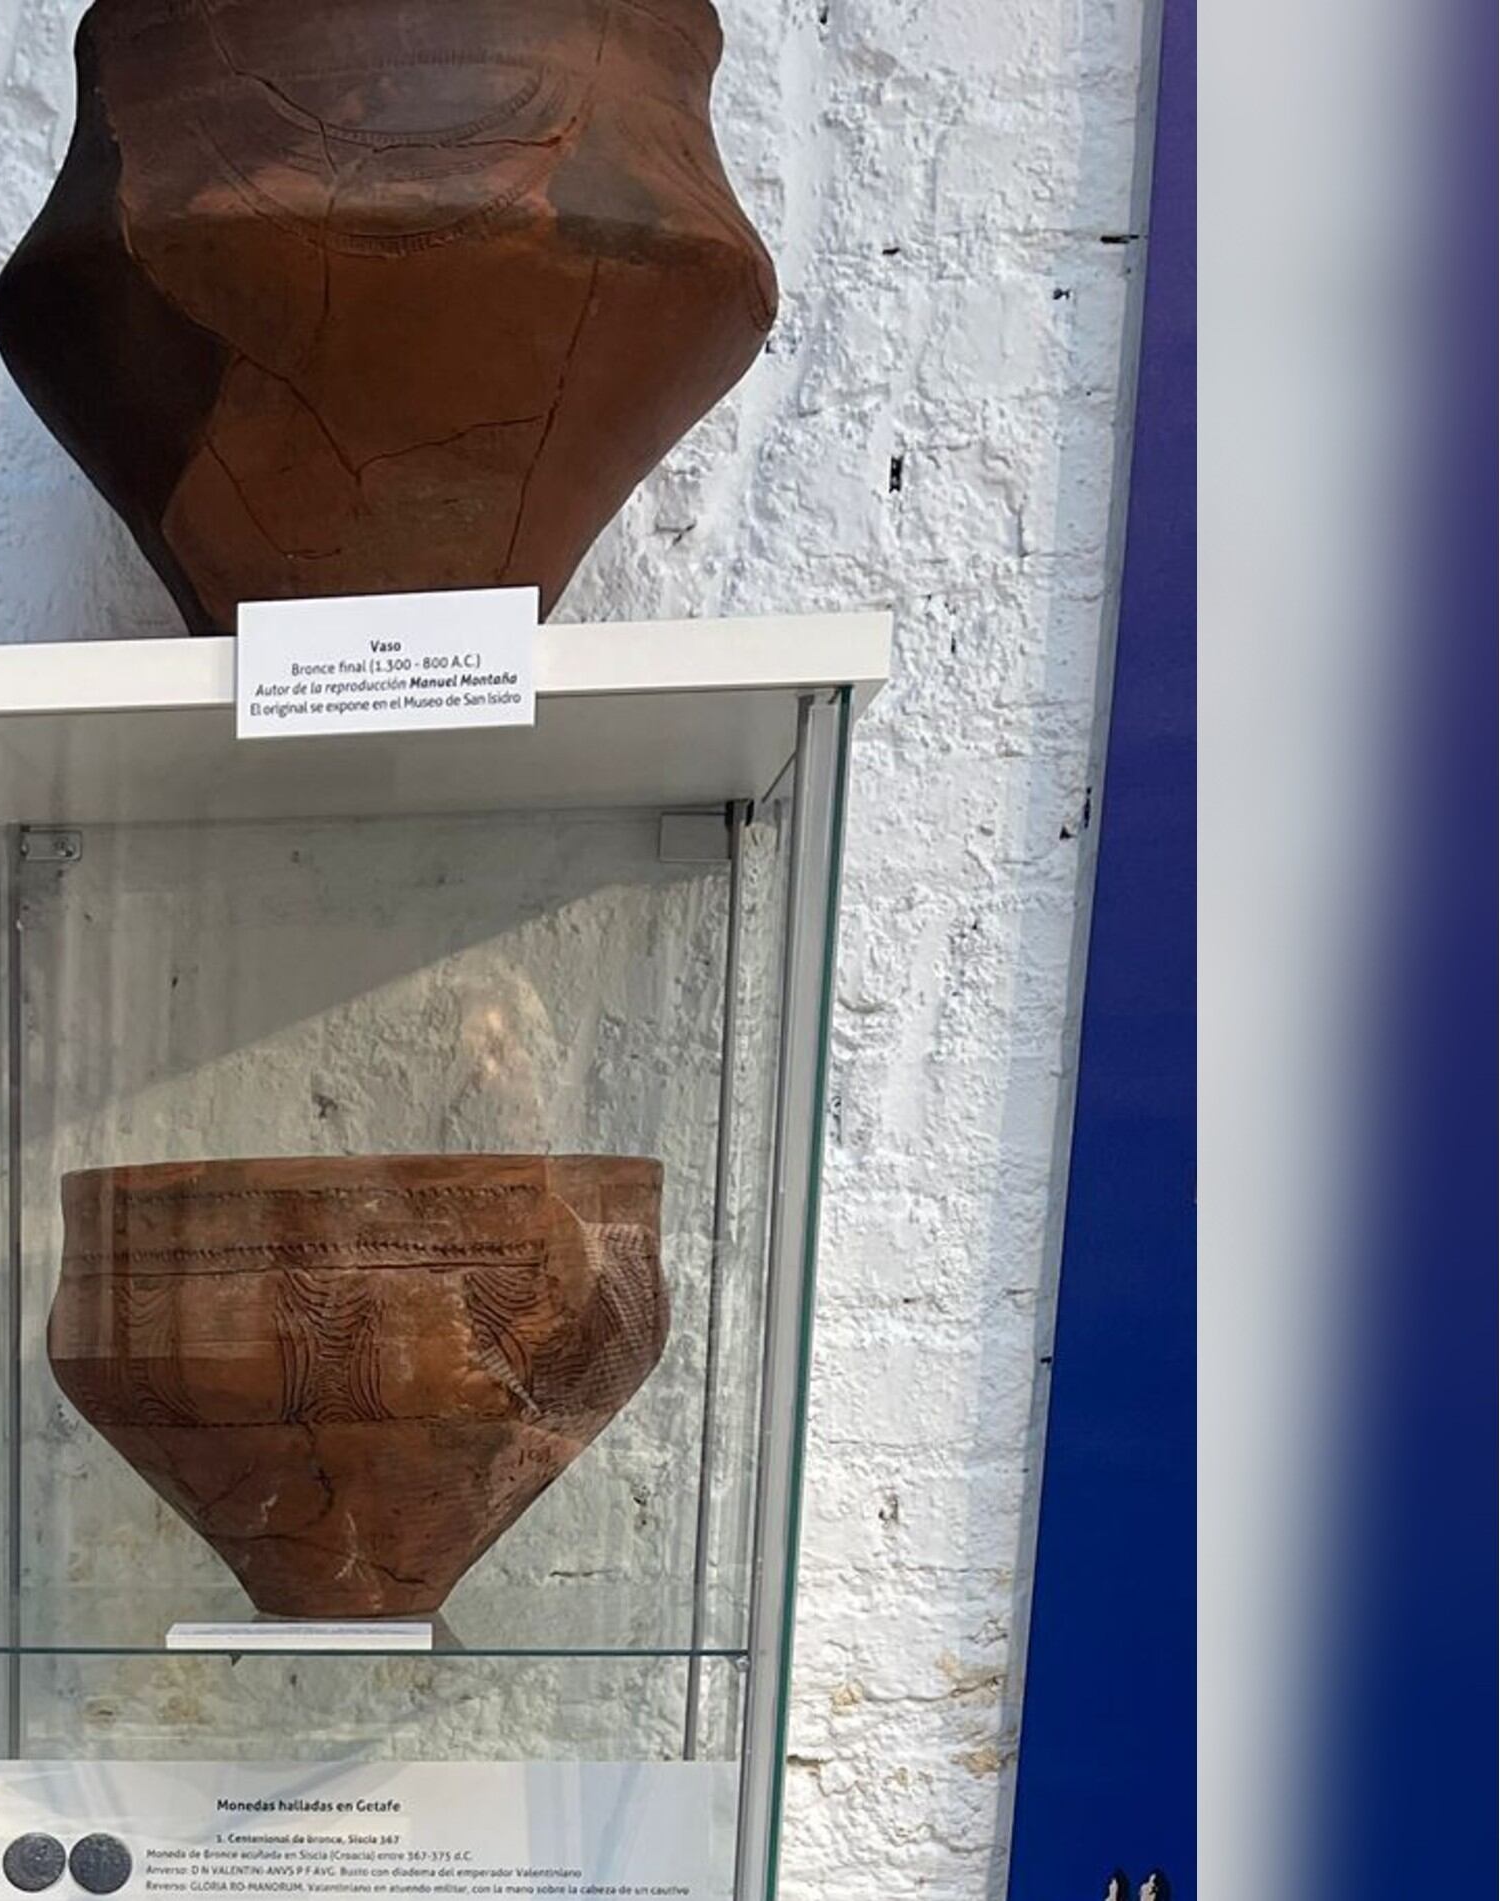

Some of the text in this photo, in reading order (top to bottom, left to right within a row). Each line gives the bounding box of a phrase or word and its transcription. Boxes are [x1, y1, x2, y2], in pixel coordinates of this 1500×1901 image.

[370, 640, 401, 652] Vaso
[291, 663, 335, 676] Bronce
[339, 660, 366, 673] final
[422, 656, 449, 669] 800
[255, 671, 517, 696] Autor de la reproducción Manuel Montaña
[250, 690, 521, 718] El original se expone en el Museo de San Isidro
[217, 1799, 401, 1812] Monedas halladas en Getafe
